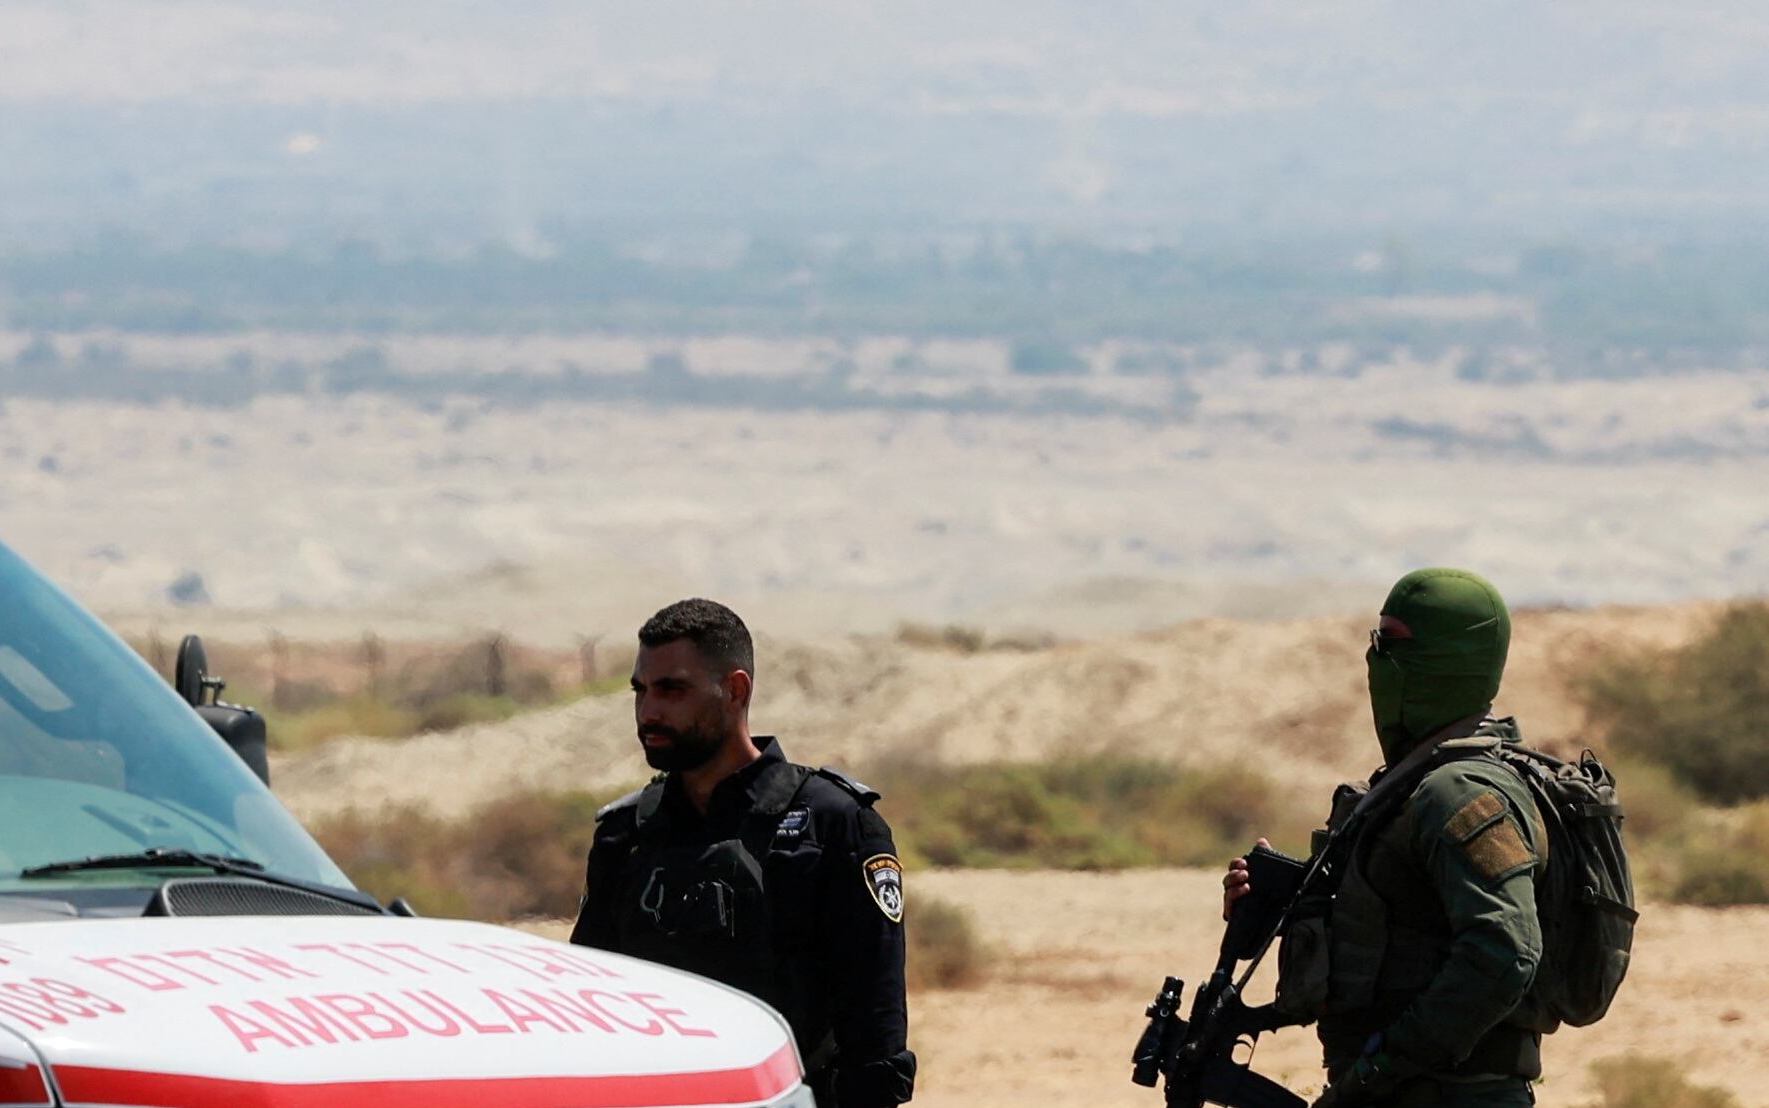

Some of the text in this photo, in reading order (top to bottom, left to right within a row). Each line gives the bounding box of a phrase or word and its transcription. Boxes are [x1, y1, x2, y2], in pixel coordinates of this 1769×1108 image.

[71, 942, 627, 992] מגן דוד אדום
[208, 988, 719, 1053] AMBULANCE
